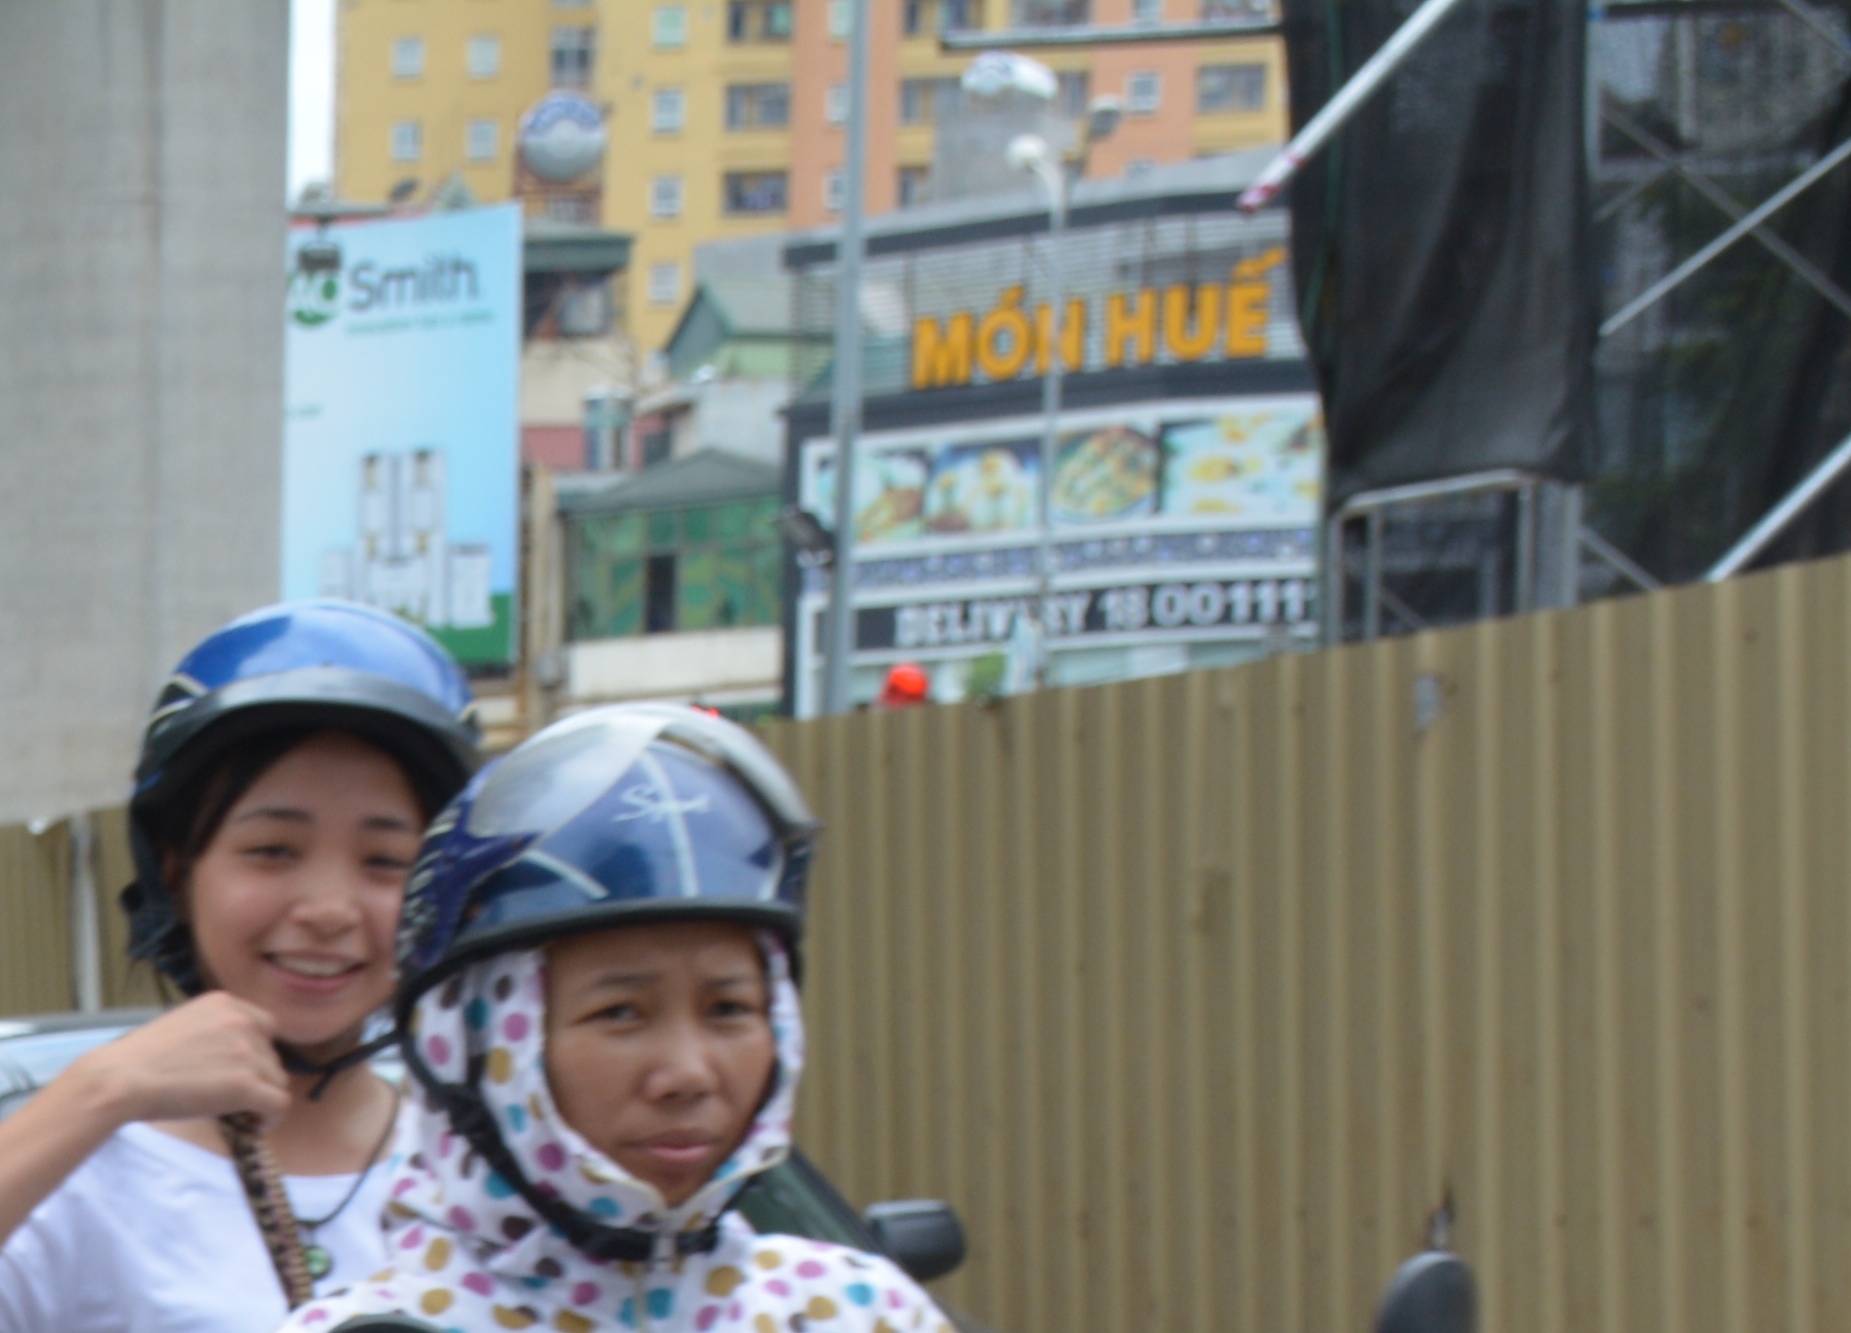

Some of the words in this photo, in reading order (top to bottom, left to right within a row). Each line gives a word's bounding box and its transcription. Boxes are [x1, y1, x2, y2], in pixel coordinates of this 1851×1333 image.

[349, 250, 480, 313] Smith
[913, 284, 1085, 390] MÓN
[1107, 246, 1288, 368] HUẾ
[896, 590, 1093, 647] DELIVRY
